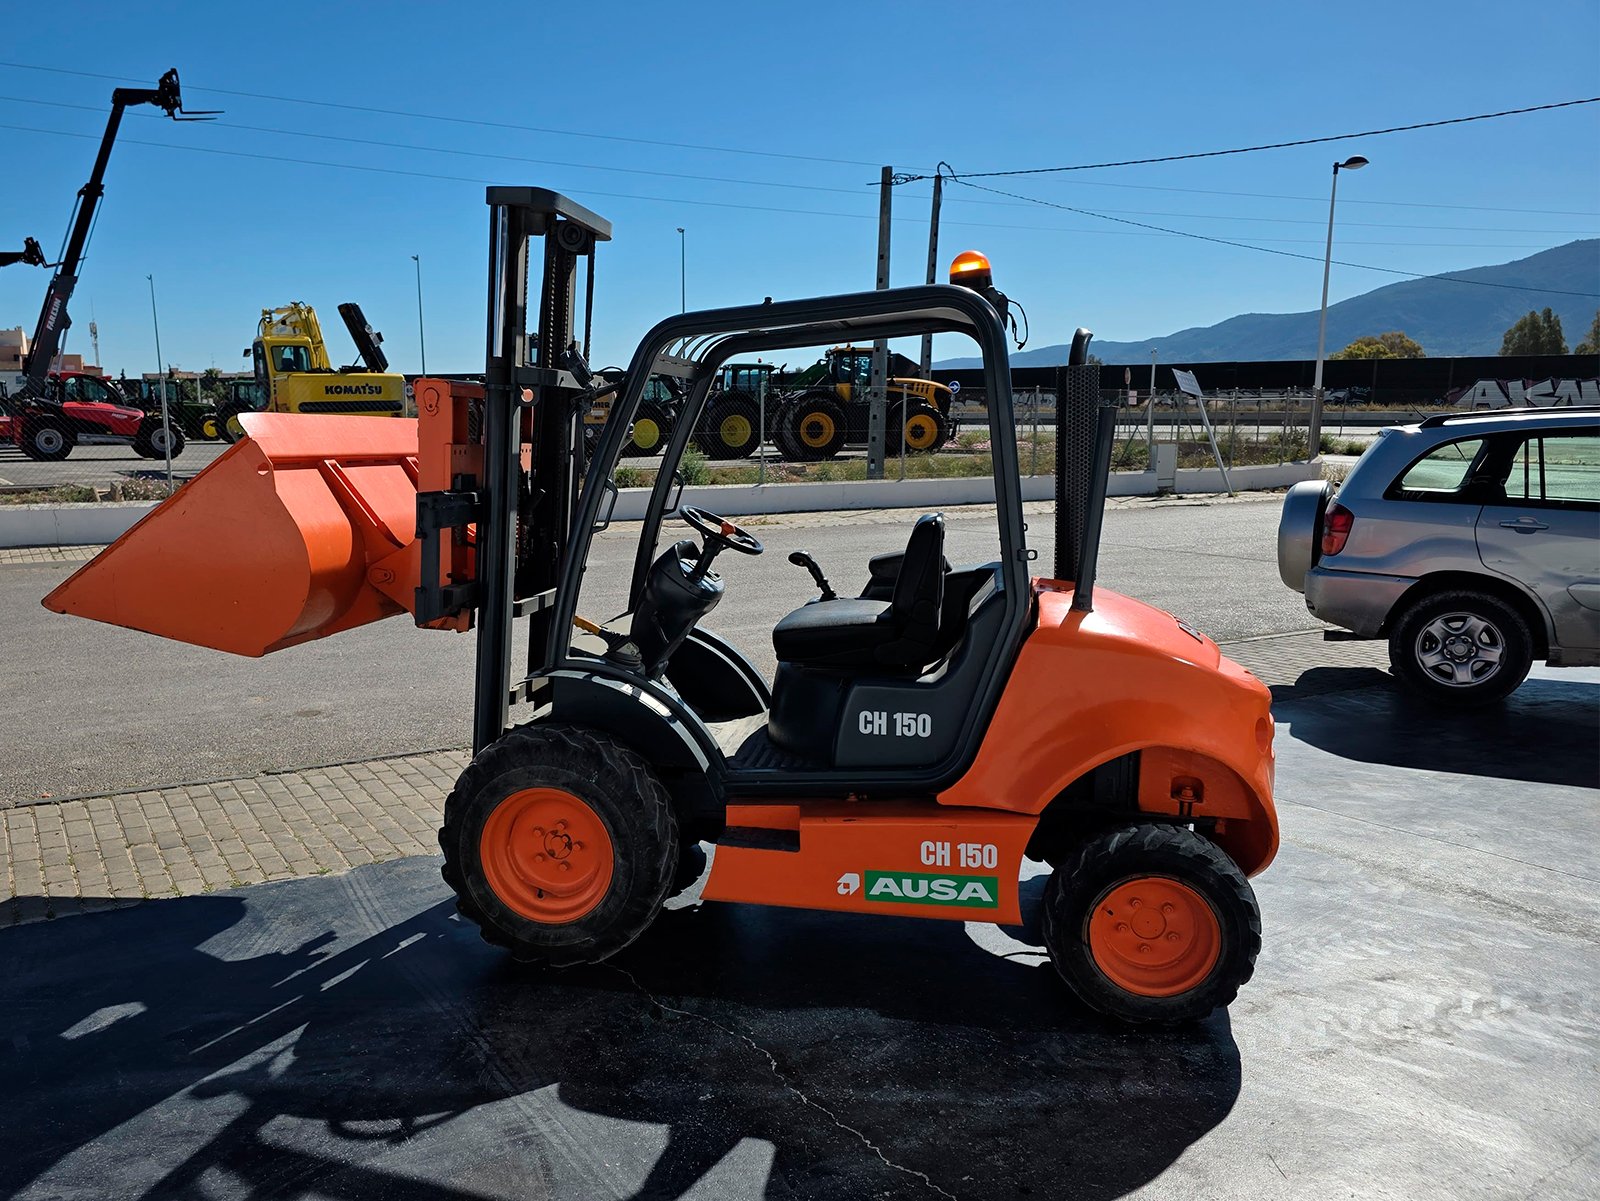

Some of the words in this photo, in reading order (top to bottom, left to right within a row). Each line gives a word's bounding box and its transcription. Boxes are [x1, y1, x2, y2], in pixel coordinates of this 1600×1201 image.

[325, 383, 382, 395] KOMATSU
[859, 710, 887, 735] CH
[893, 712, 932, 738] 150
[920, 840, 951, 867] CH
[957, 842, 998, 869] 150
[868, 877, 994, 902] AUSA
